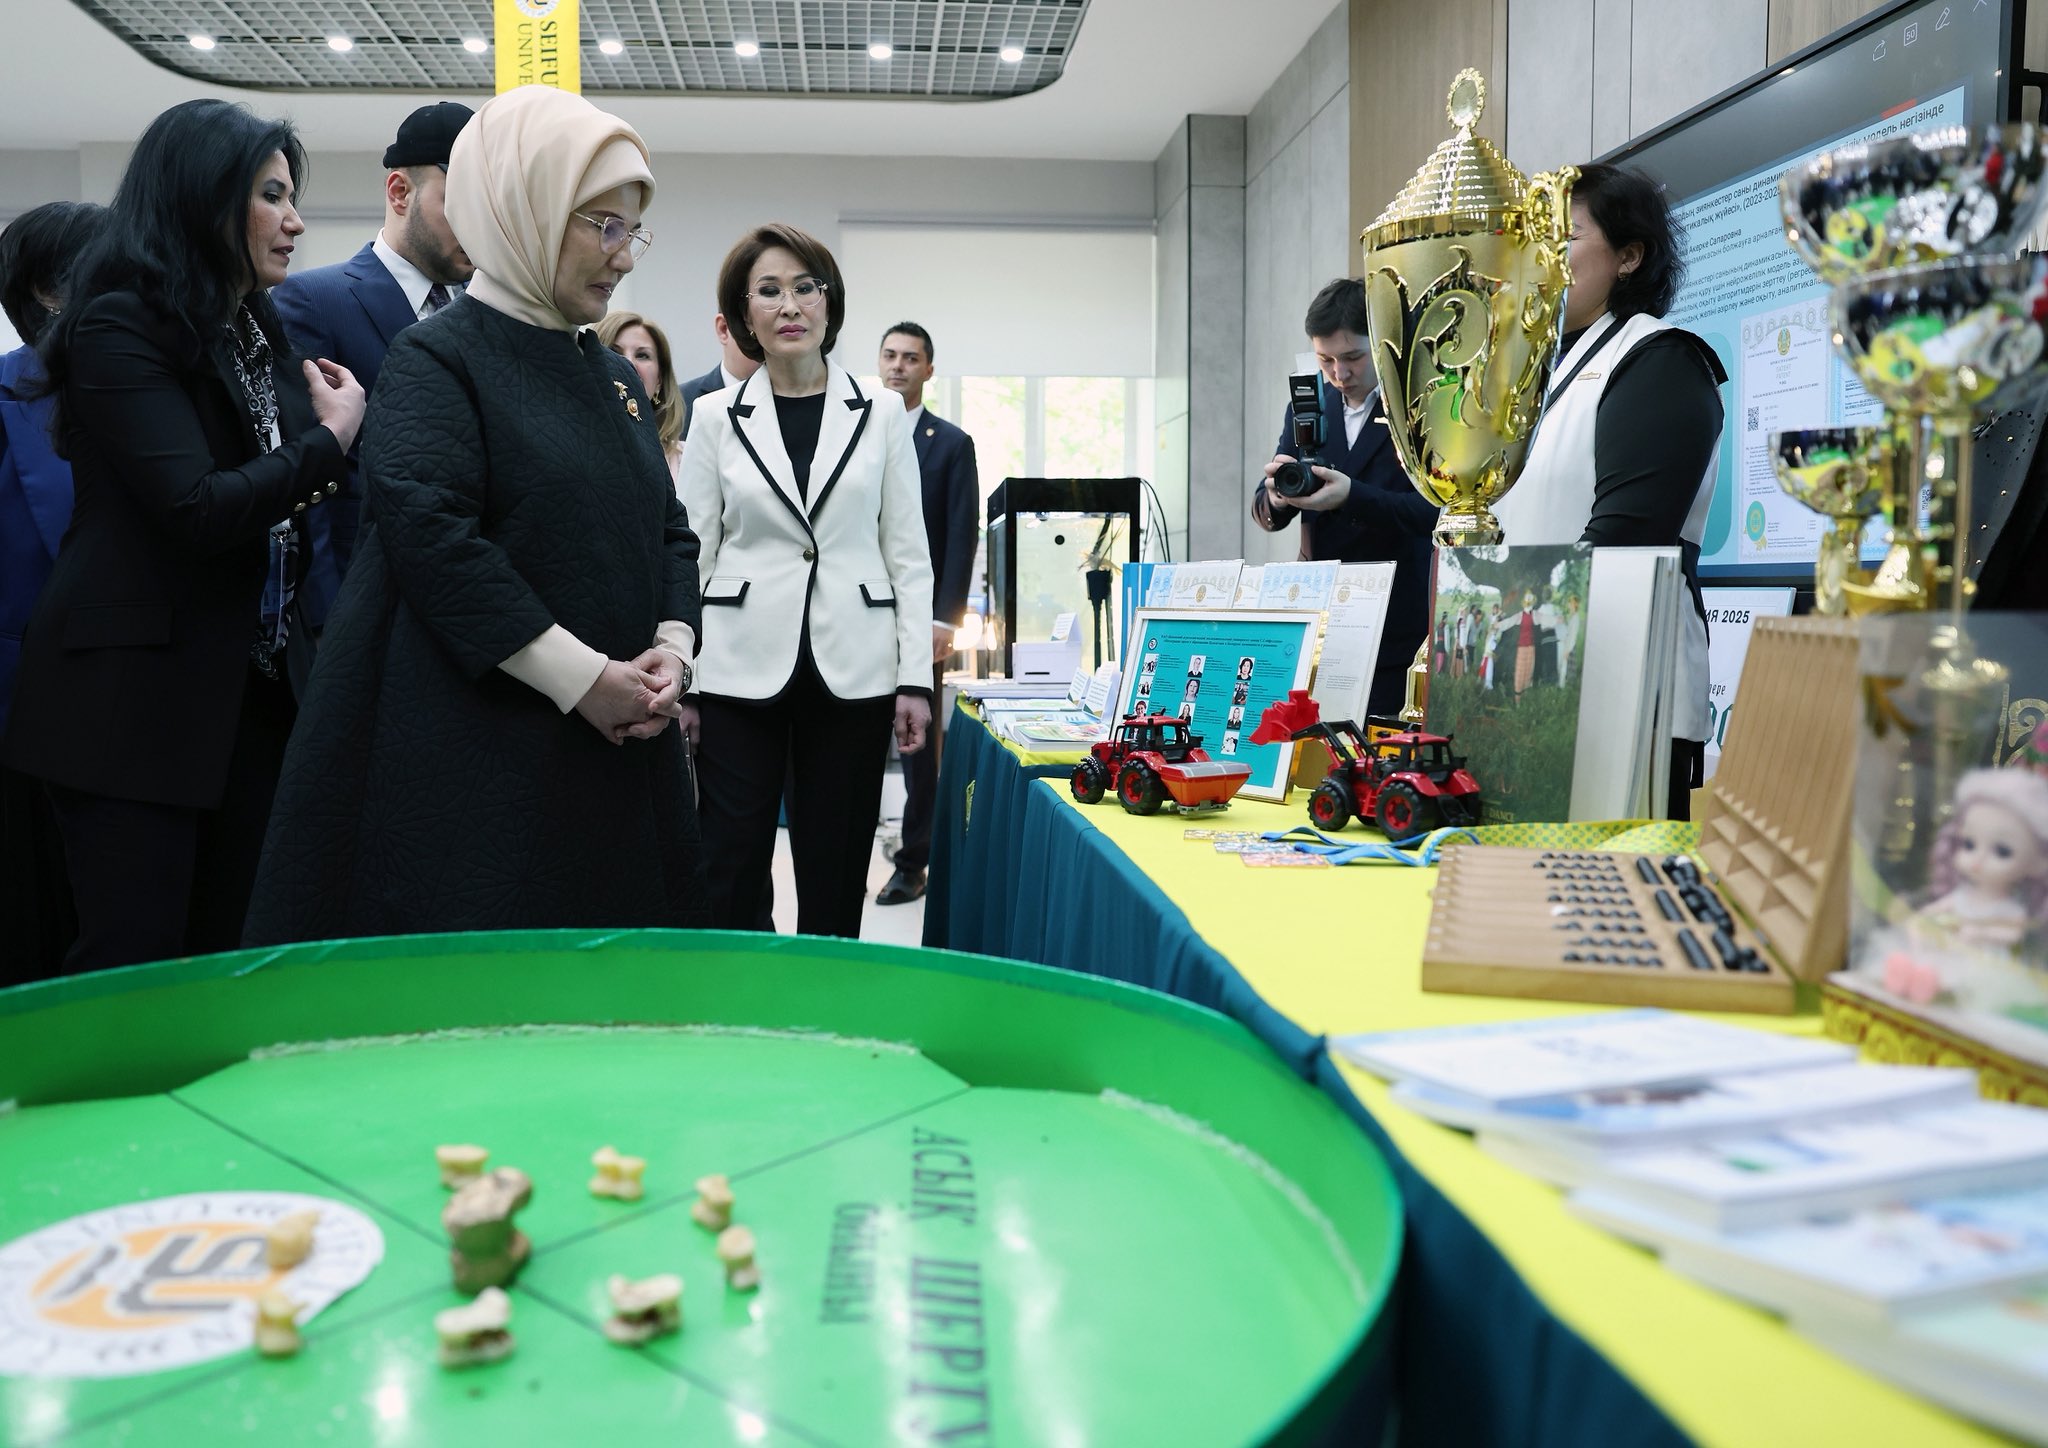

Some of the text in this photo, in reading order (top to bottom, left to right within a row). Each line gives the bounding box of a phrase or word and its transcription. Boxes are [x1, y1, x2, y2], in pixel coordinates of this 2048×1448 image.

[540, 20, 558, 88] SEIFU
[1906, 29, 1916, 41] 50
[1733, 184, 1752, 199] саны
[1900, 103, 1944, 130] негізінде
[1721, 610, 1750, 624] 2025
